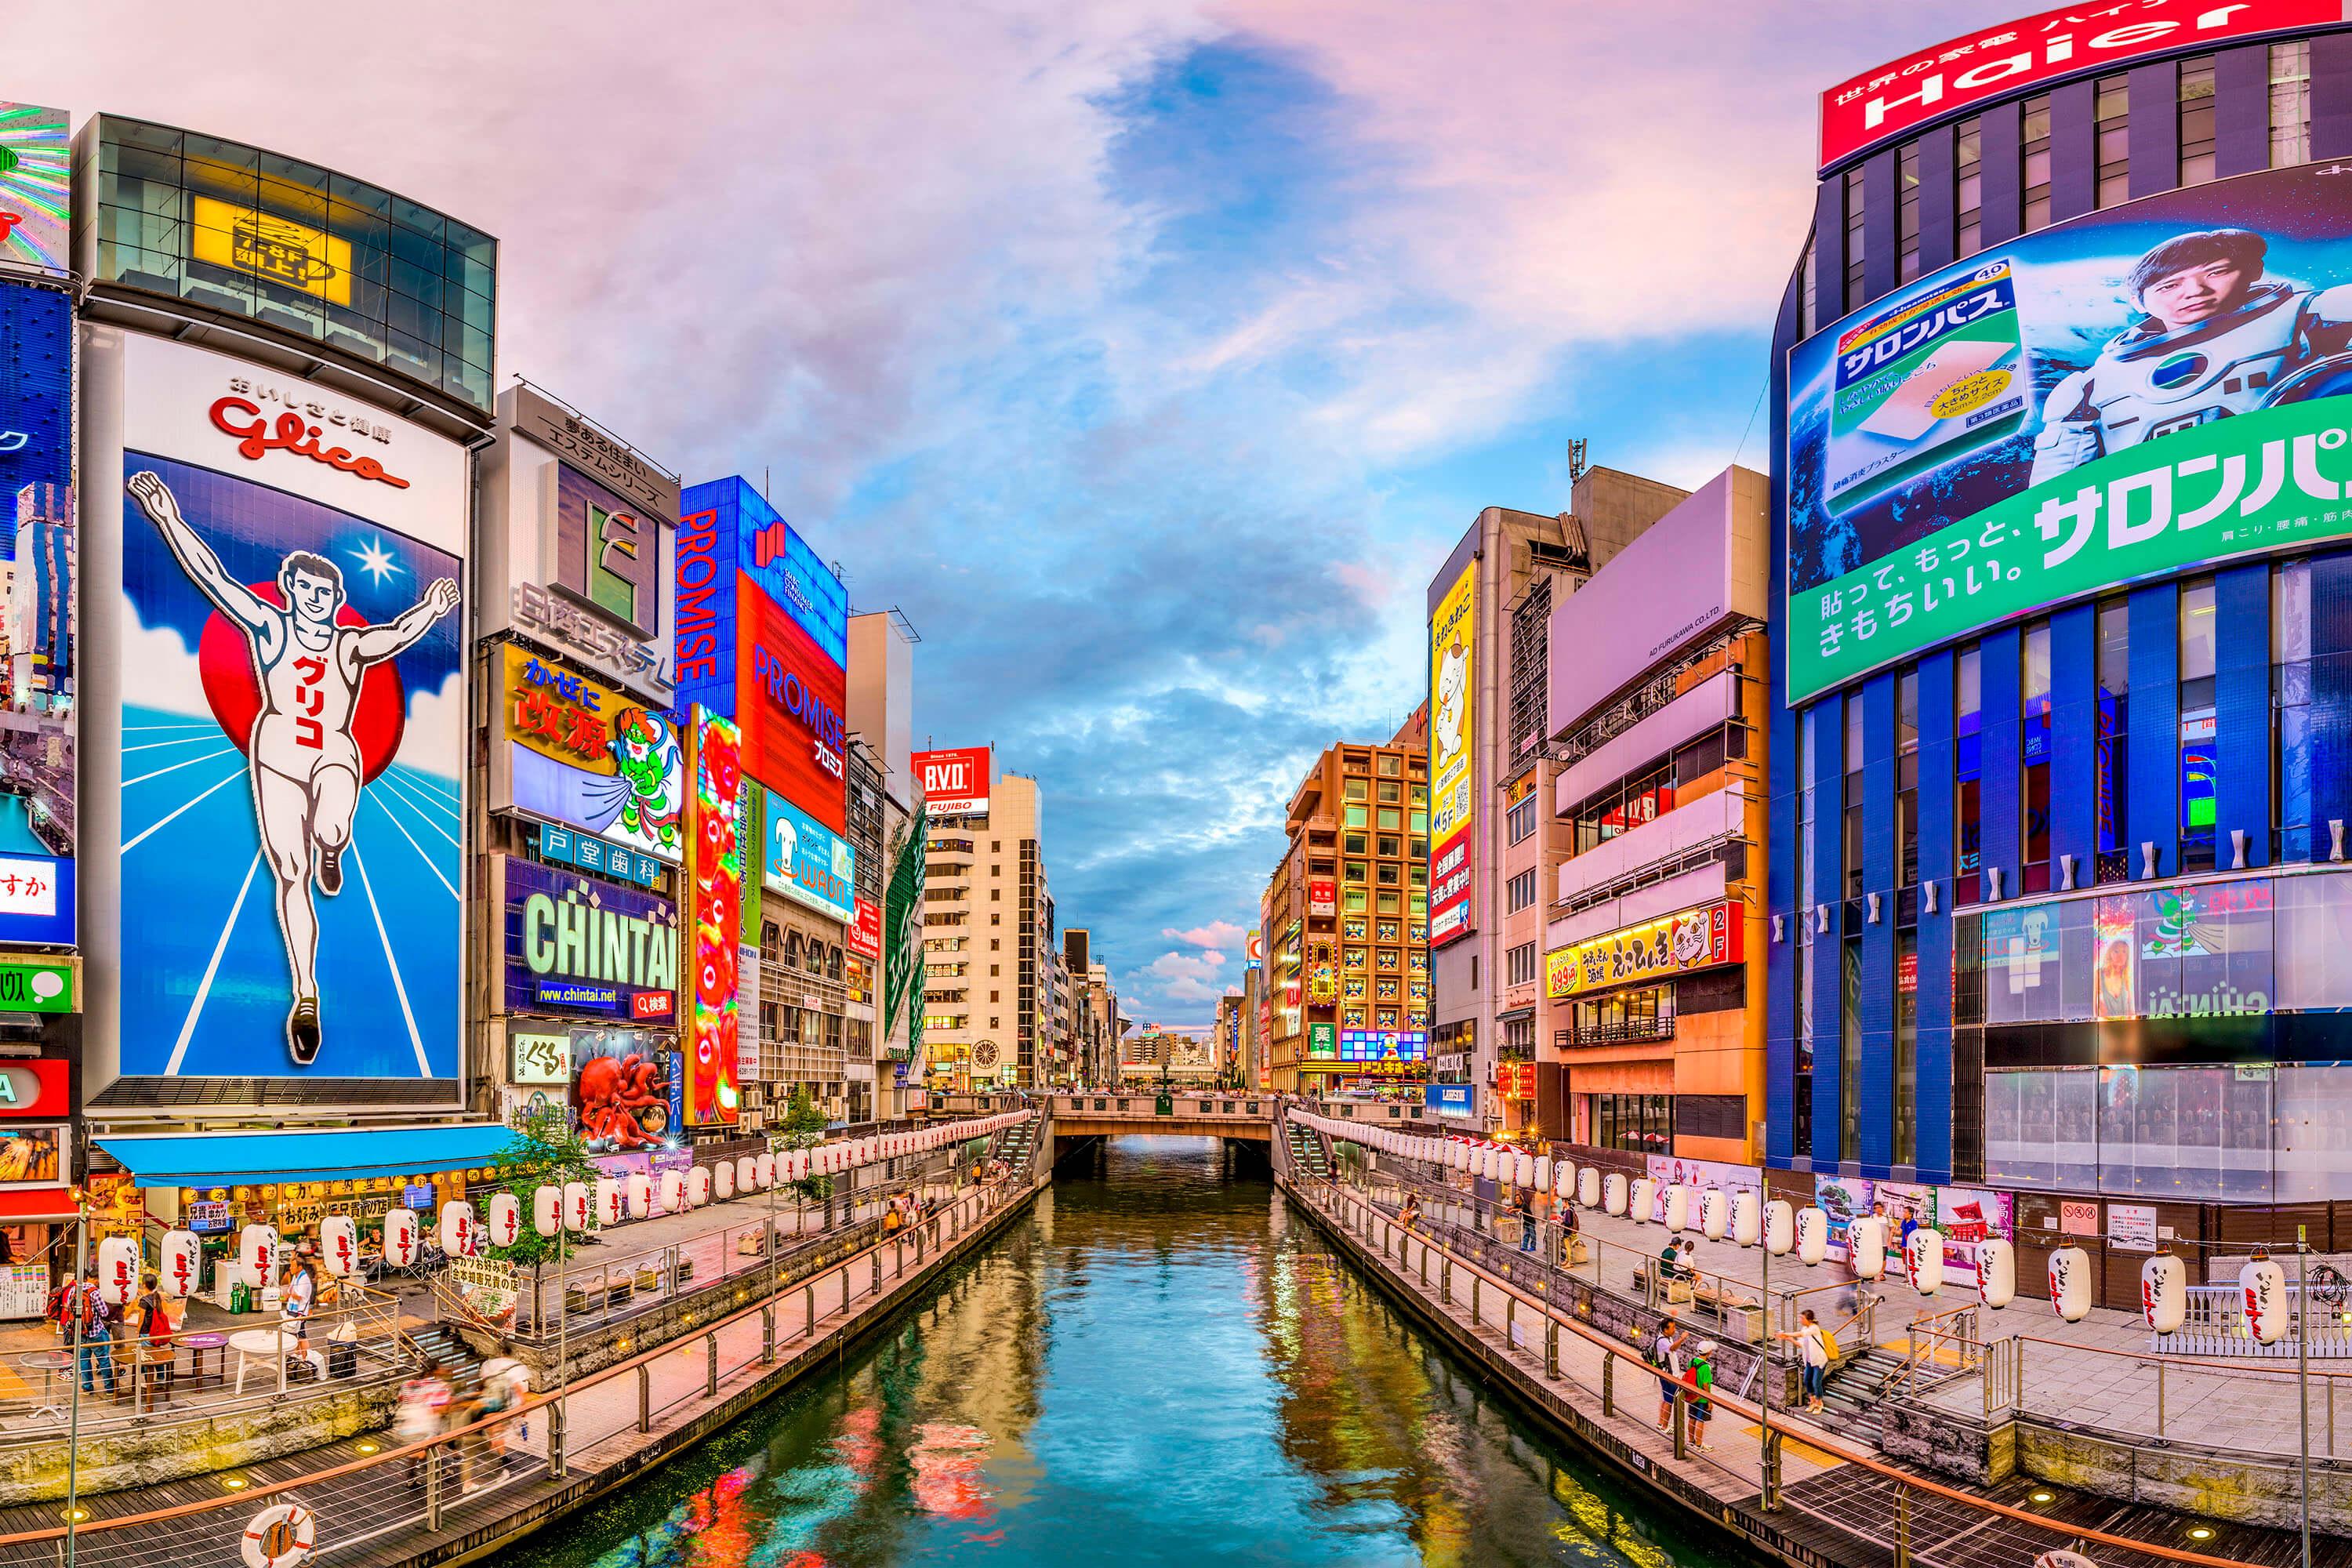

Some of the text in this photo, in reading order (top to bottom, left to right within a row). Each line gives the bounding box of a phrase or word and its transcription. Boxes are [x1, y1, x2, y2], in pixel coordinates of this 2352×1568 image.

[1835, 31, 2018, 107] 世界の家電
[1864, 3, 2252, 130] Haier
[1978, 264, 2003, 278] 40
[1845, 288, 2003, 379] サロンパス
[1939, 377, 2004, 411] 大きめサイズ
[1952, 376, 1988, 395] ちょっと
[230, 376, 393, 445] おいしさと健康
[1970, 397, 2019, 424] 第3類医薬品
[209, 396, 410, 488] Glico
[564, 416, 647, 477] 夢ある住まい
[549, 428, 659, 508] エステムシリーズ
[1833, 449, 1906, 492] 鎮痛消炎プラスター
[2034, 428, 2352, 571] サロンパ
[677, 508, 717, 682] PROMISE
[784, 568, 801, 586] SMBC
[784, 576, 814, 612] CONSUMER
[784, 587, 808, 615] FINANCE
[1820, 560, 2022, 659] きもちいい。
[1649, 648, 1657, 659] AD
[1658, 623, 1693, 651] FURUKAWA
[292, 655, 329, 751] グリコ
[525, 658, 601, 712] かぜに
[754, 644, 844, 756] PROMISE
[514, 686, 608, 760] 改源
[815, 739, 844, 781] プロミス
[925, 764, 967, 792] B.V.D.
[929, 801, 972, 813] FUJIBO
[1442, 809, 1454, 833] 5F
[548, 829, 655, 881] 戸堂歯科
[739, 780, 749, 938] 株式会社日本リート
[800, 858, 844, 904] WAON
[1612, 930, 1669, 978] えこひいき
[1551, 964, 1577, 993] 299円
[1587, 966, 1605, 983] 酒場
[649, 996, 668, 1011] 検索
[1315, 1026, 1330, 1042] 薬
[525, 1040, 560, 1076] くくる
[190, 1205, 207, 1219] 兄貴
[208, 1208, 227, 1218] 串カツ
[285, 1206, 320, 1225] お好み
[452, 1258, 510, 1276] 串カツお好み焼
[452, 1269, 519, 1294] 金本知憲兄貴の店
